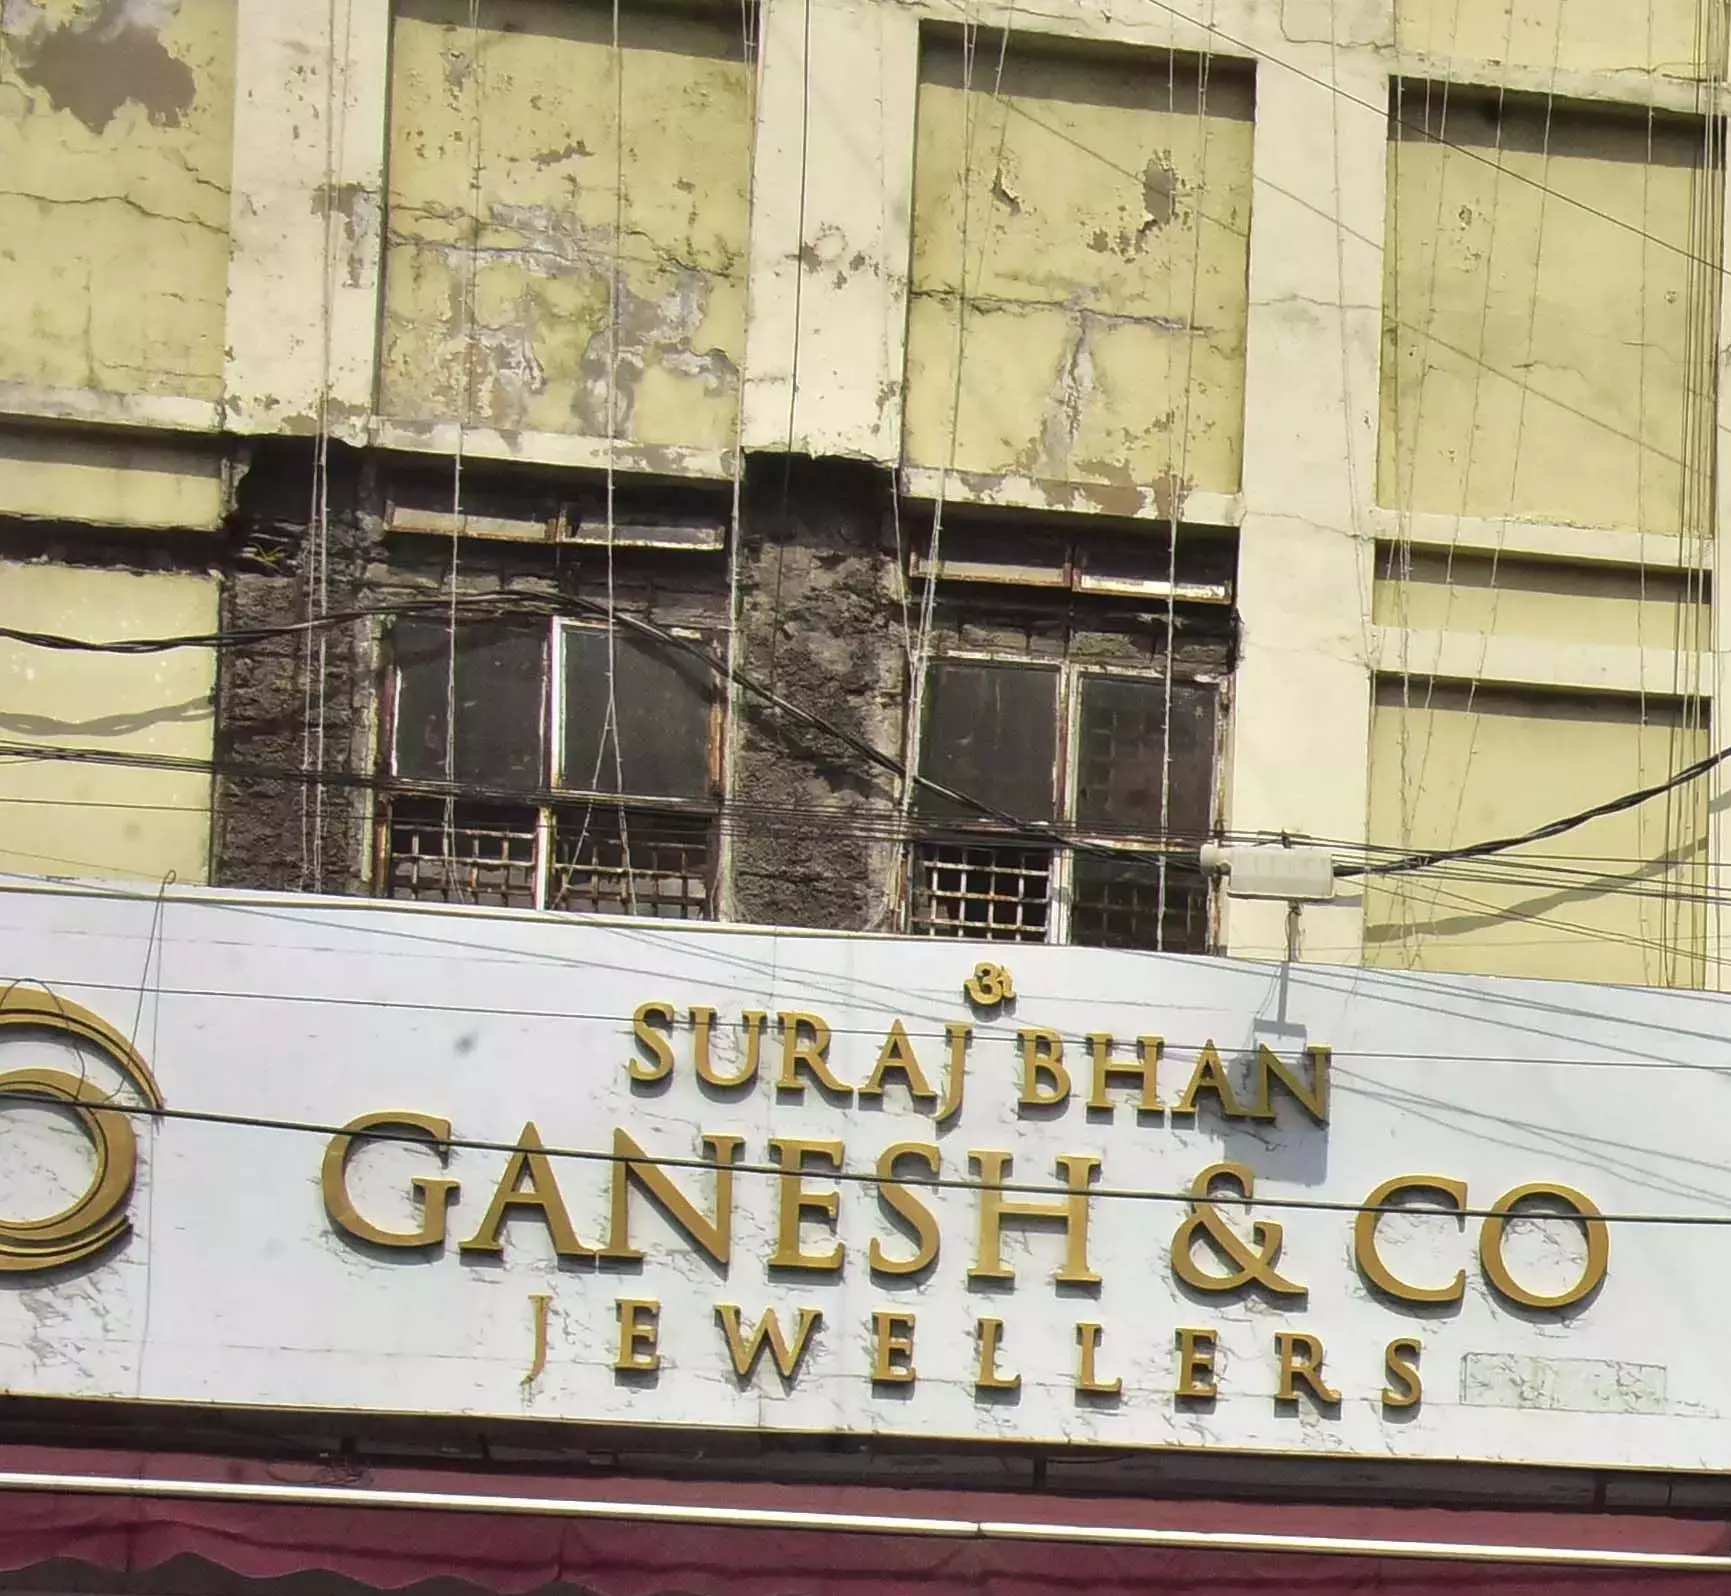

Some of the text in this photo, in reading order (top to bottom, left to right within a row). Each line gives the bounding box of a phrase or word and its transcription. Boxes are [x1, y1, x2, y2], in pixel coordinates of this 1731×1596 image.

[628, 1002, 1332, 1126] SURAJ BHAN
[321, 1110, 1610, 1310] GANESH & CO
[520, 1292, 1423, 1409] JEWELLERS
